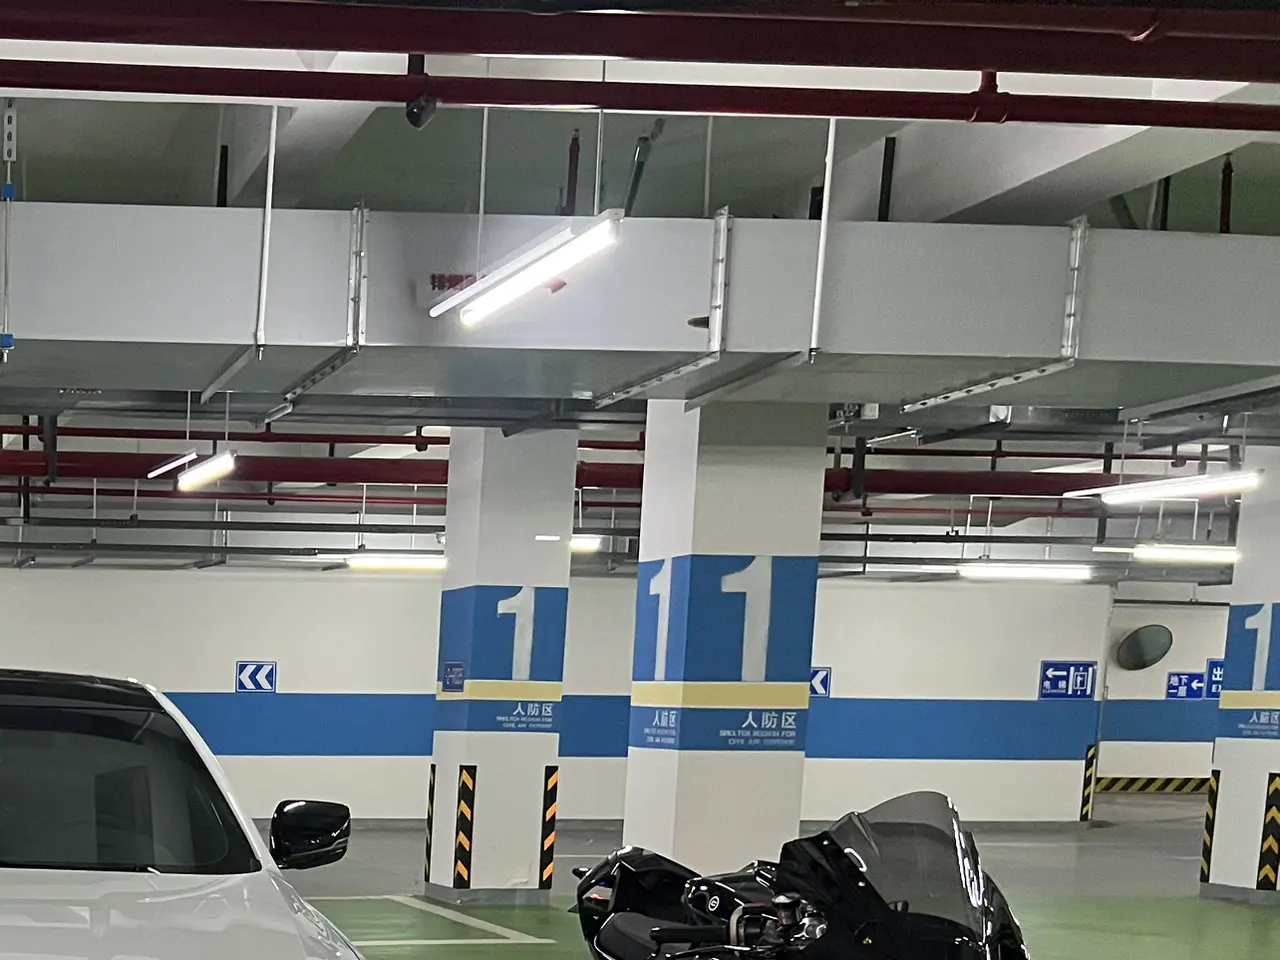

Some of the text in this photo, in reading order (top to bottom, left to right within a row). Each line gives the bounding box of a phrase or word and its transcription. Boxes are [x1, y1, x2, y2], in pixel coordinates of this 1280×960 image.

[497, 586, 535, 680] 1
[649, 557, 673, 681] 1
[721, 555, 773, 681] 1
[513, 702, 552, 716] 人防区
[742, 711, 797, 728] 人防区
